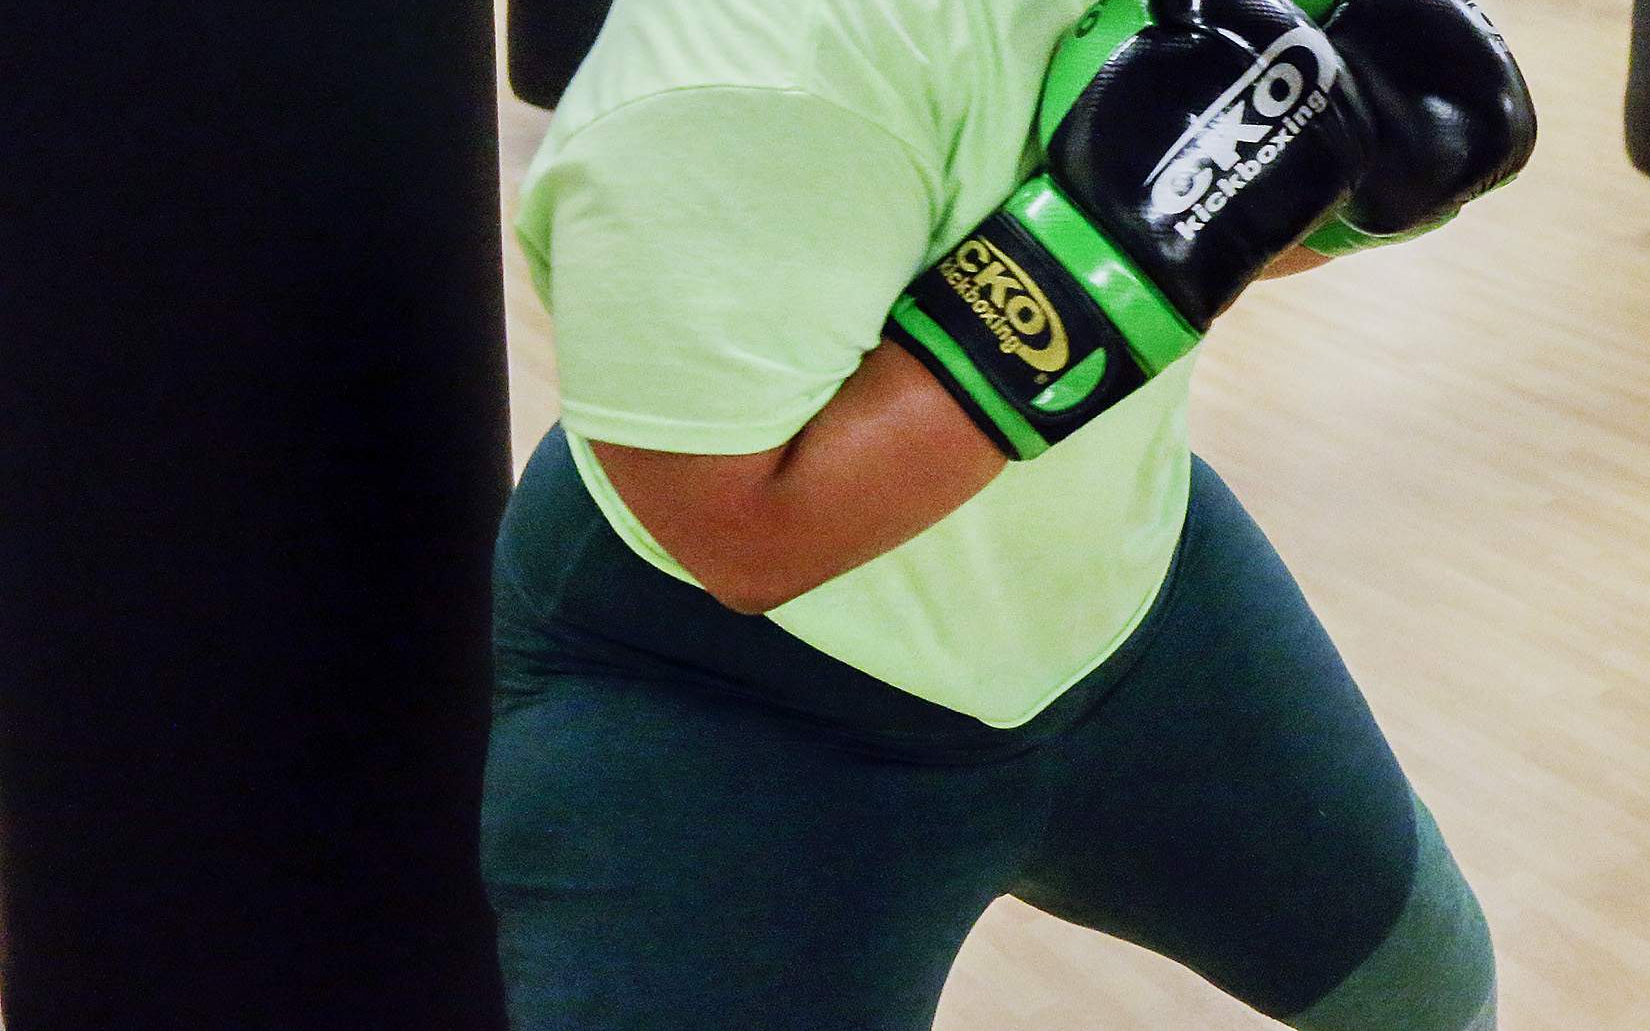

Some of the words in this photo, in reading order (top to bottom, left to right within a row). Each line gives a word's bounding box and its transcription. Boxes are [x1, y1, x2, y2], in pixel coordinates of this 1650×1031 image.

[1151, 62, 1304, 216] CKO
[1173, 89, 1329, 241] kickboxing
[956, 240, 1047, 336] CKO
